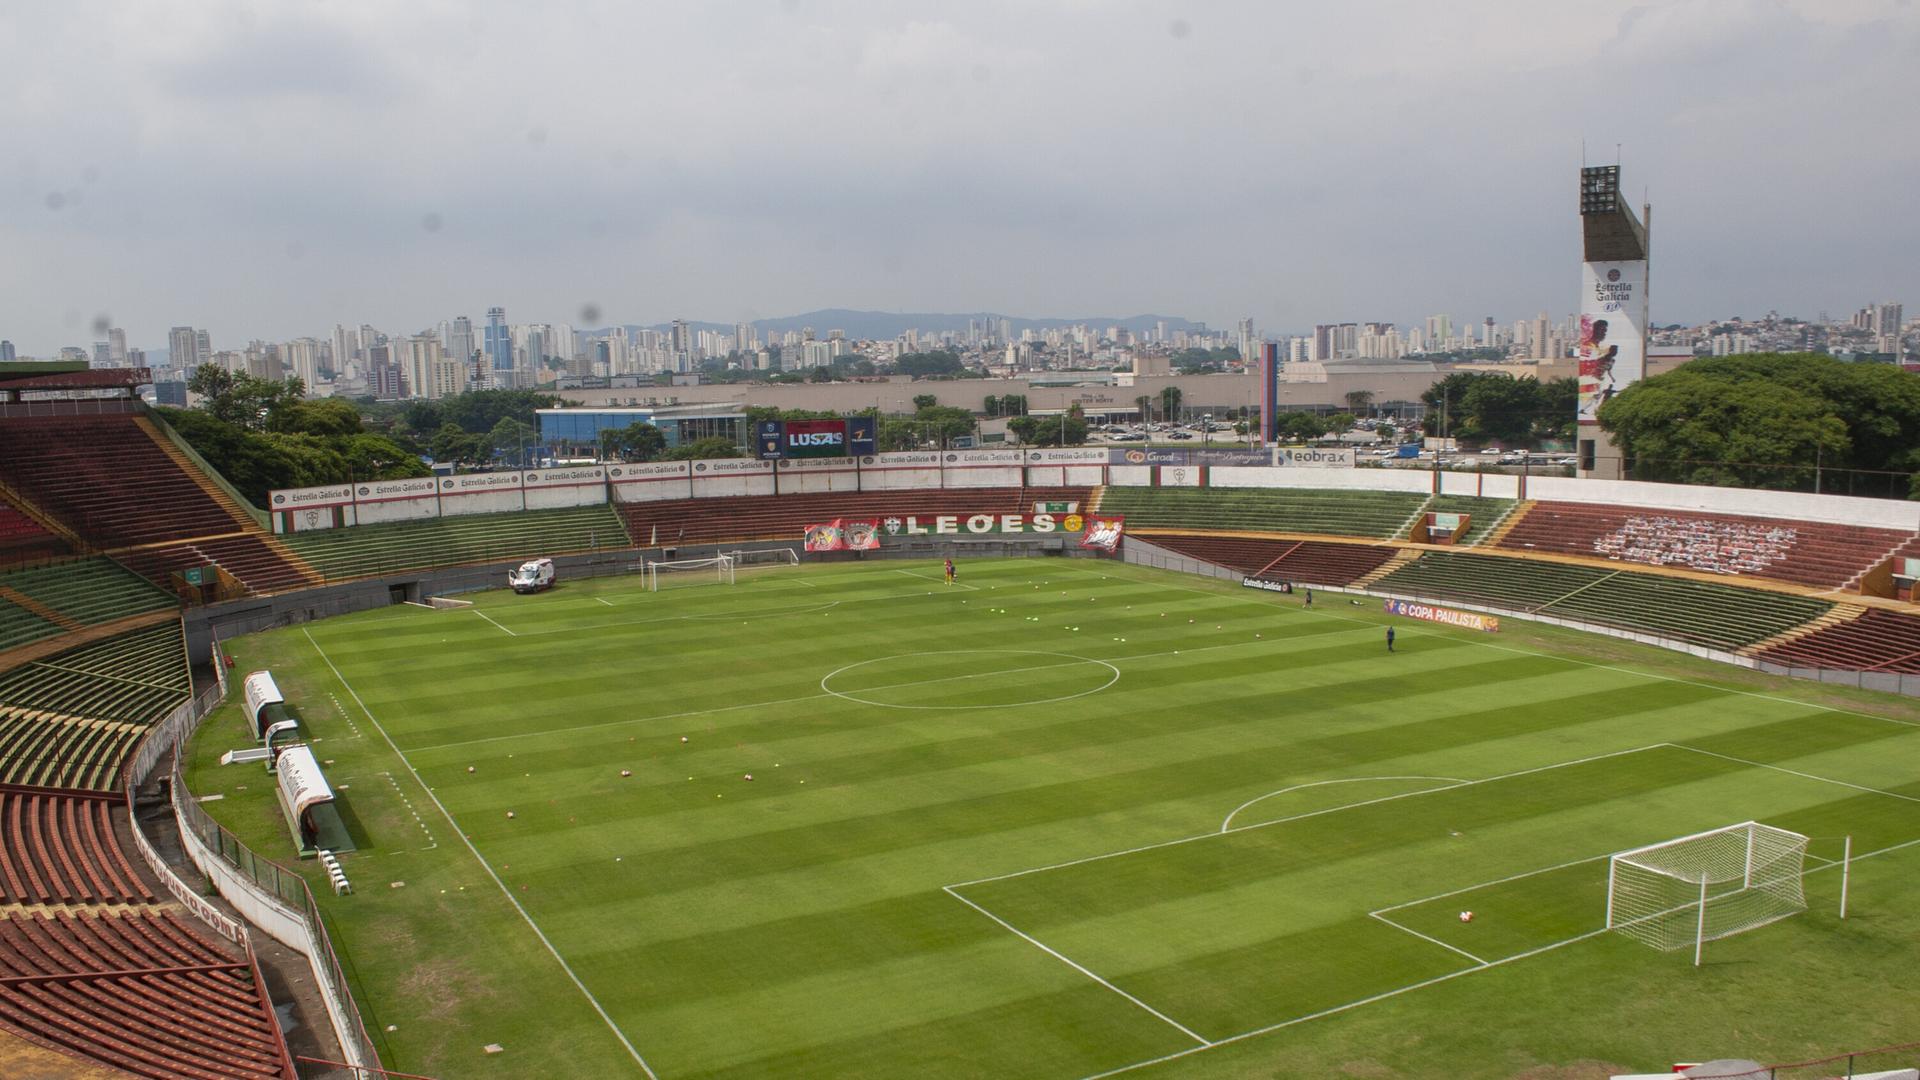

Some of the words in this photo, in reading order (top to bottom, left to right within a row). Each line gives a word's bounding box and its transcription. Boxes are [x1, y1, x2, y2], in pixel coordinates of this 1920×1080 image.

[1595, 282, 1632, 292] Estrella
[1596, 292, 1630, 302] Galicia
[789, 432, 832, 447] LUSA
[1147, 451, 1175, 462] Graal
[628, 467, 653, 475] Estrella
[653, 465, 678, 474] Galicia
[713, 463, 738, 471] Estrella
[739, 462, 762, 470] Galicia
[461, 478, 486, 487] Estrella
[487, 476, 510, 485] Galicia
[545, 472, 570, 481] Estrella
[570, 471, 593, 480] Galicia
[376, 486, 401, 494] Estrella
[402, 483, 425, 492] Galicia
[292, 491, 318, 502] Estrella
[319, 490, 342, 500] Galicia
[1408, 604, 1434, 620] COPA
[1435, 609, 1482, 628] PAULISTA
